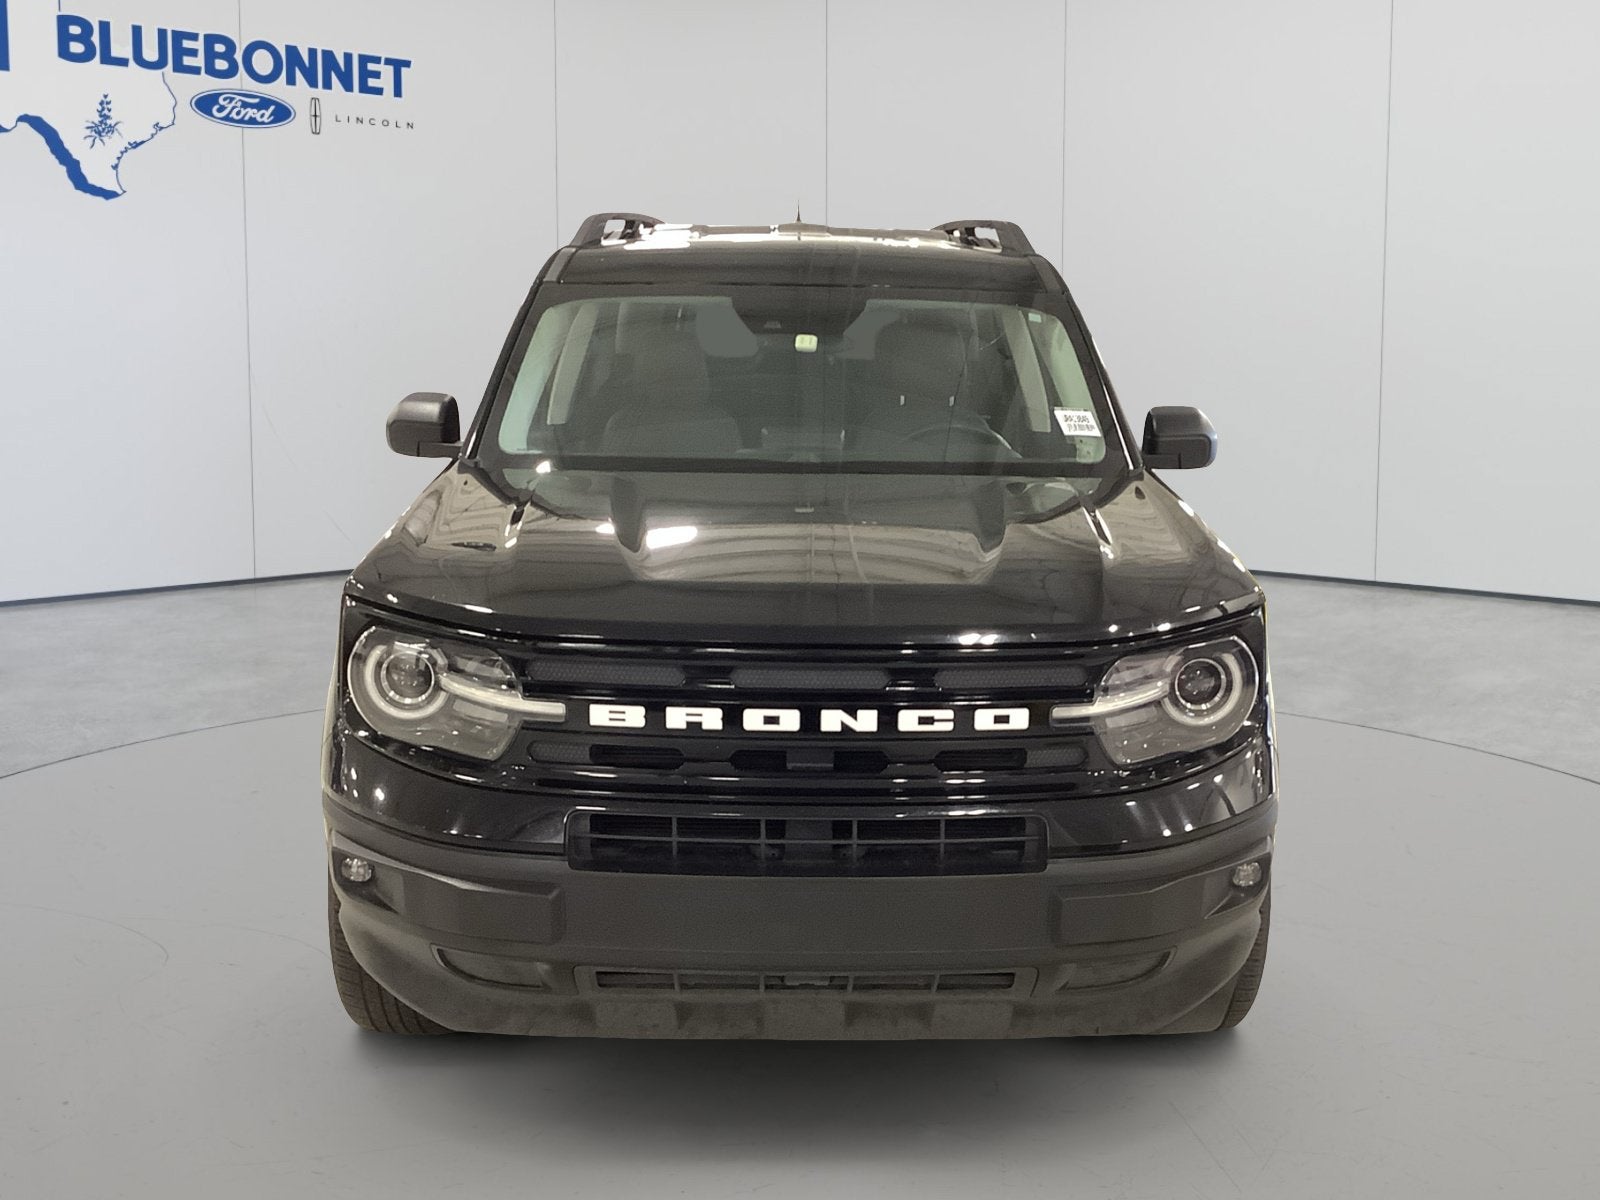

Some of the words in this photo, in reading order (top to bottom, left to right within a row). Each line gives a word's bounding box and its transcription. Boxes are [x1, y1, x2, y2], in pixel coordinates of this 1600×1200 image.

[57, 14, 412, 98] BLUEBONNET
[211, 93, 275, 124] Ford
[335, 115, 415, 130] LINCOLN
[588, 703, 1030, 732] BRONCO
